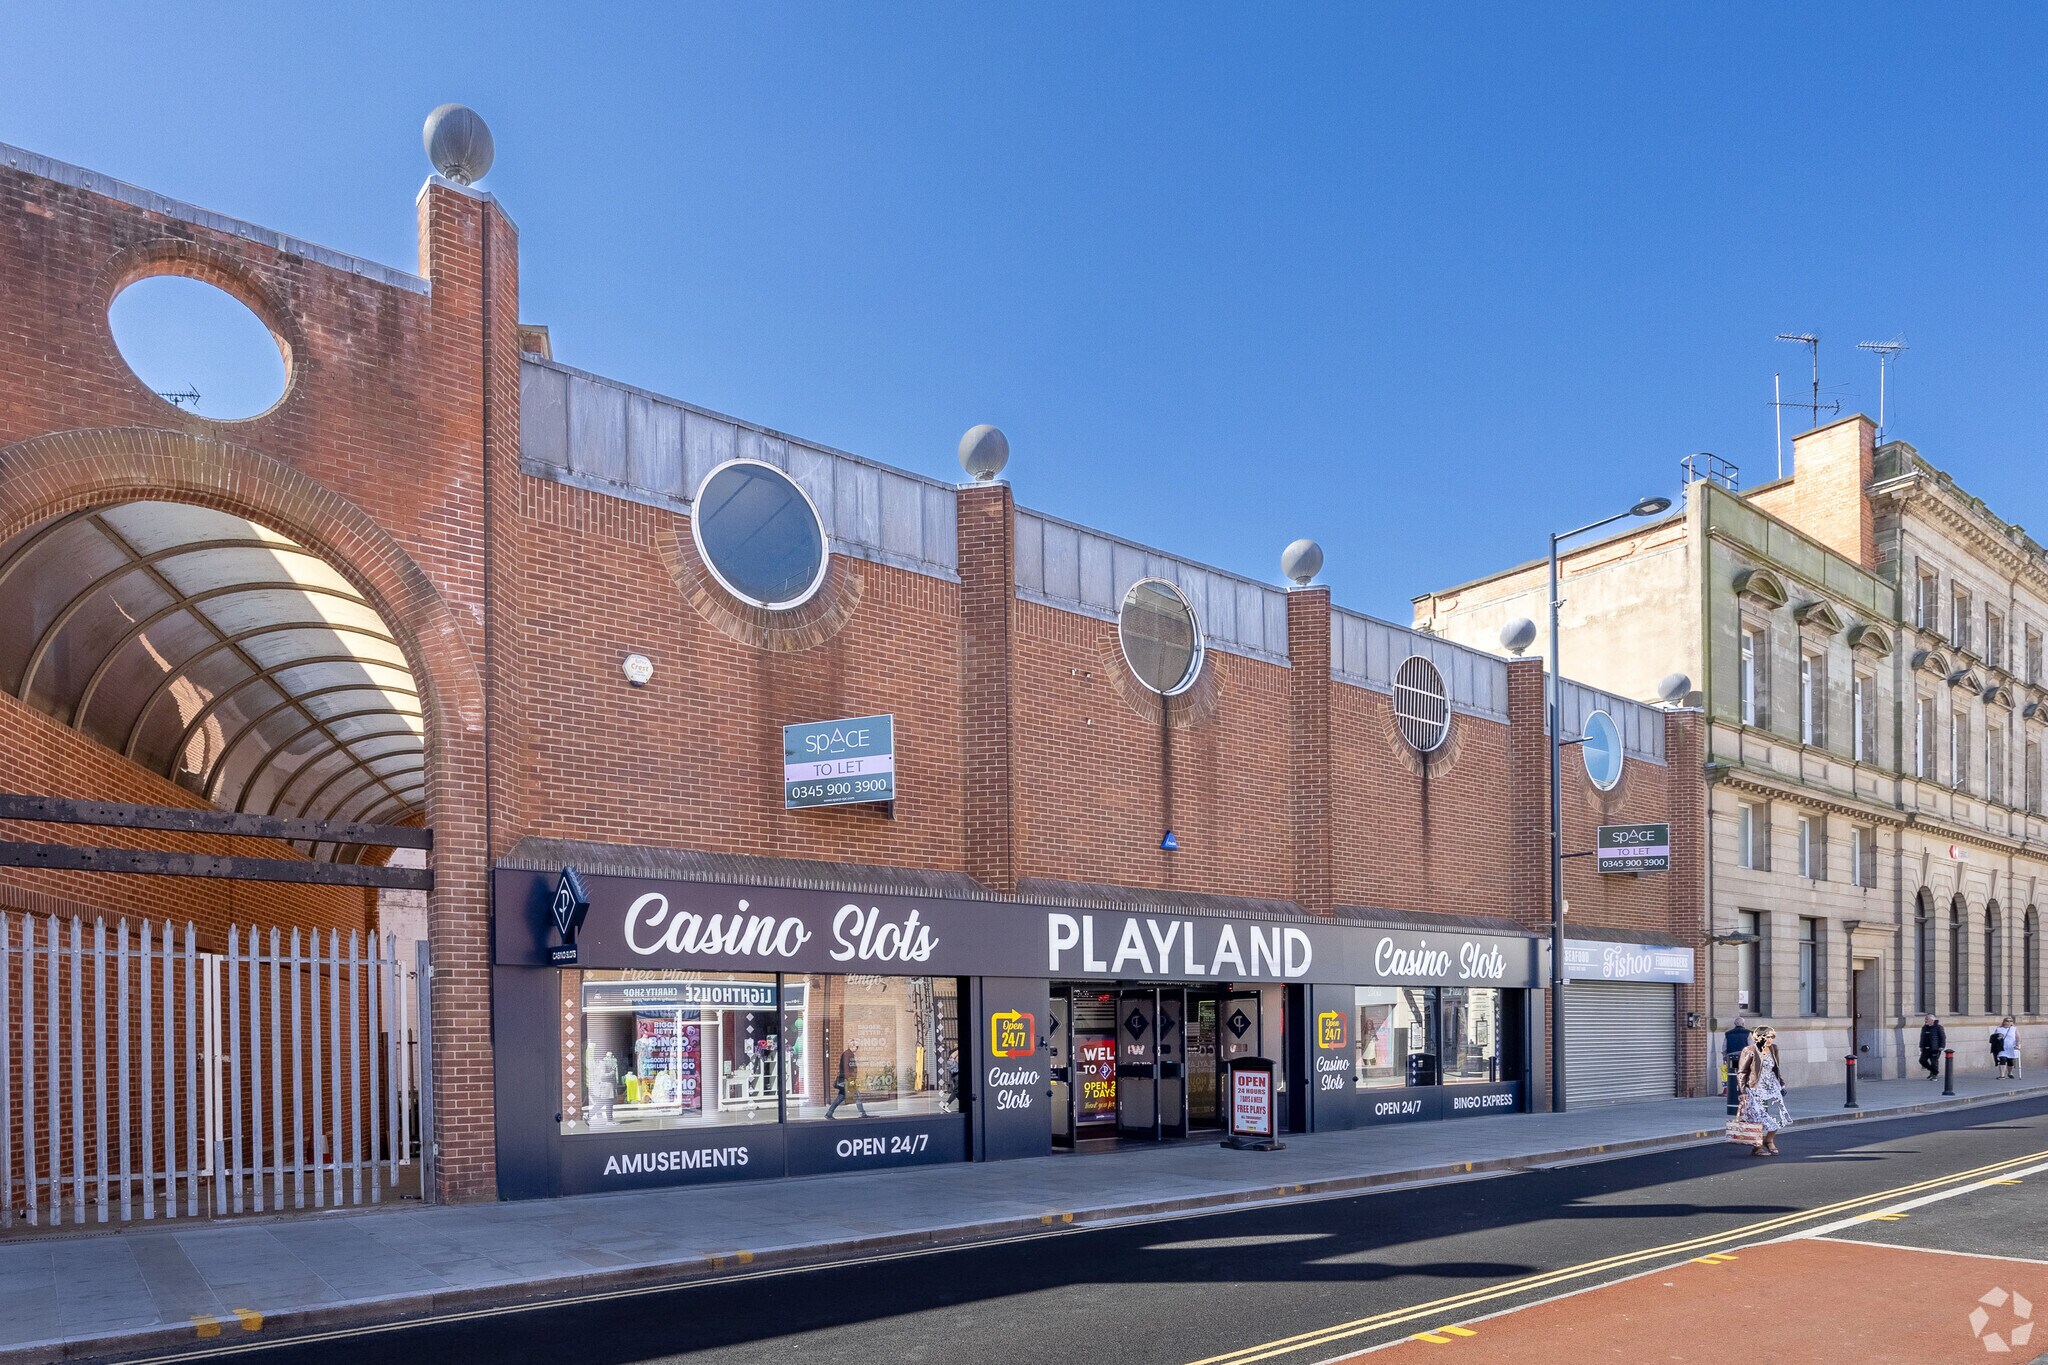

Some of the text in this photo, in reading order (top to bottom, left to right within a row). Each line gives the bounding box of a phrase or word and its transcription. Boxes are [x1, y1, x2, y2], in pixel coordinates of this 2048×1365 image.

[813, 760, 864, 777] TO LET
[792, 779, 887, 799] 0345 900 3900
[1643, 858, 1665, 866] 3900
[624, 892, 939, 961] Casino Slots
[1048, 913, 1312, 977] PLAYLAND
[1375, 937, 1506, 979] Casino Slots
[1564, 950, 1590, 963] SEAFOOD
[1602, 946, 1652, 977] Fishoo
[1002, 1020, 1024, 1033] Open
[1325, 1019, 1340, 1030] Open
[1001, 1032, 1026, 1047] 24/7
[1325, 1028, 1341, 1041] 24/7
[1084, 1048, 1115, 1061] WEL
[1083, 1065, 1097, 1075] TO
[1316, 1056, 1350, 1072] Casino
[988, 1066, 1040, 1087] Casino
[1238, 1076, 1266, 1087] OPEN
[1321, 1074, 1345, 1091] Slots
[1084, 1082, 1108, 1090] OPEN
[996, 1089, 1033, 1110] Slots
[1085, 1089, 1115, 1099] 7 DAYS
[1454, 1094, 1512, 1109] BINGO EXPRESS
[1237, 1104, 1266, 1115] FREE PLAYS
[1375, 1100, 1421, 1115] OPEN 24/7
[837, 1134, 929, 1157] OPEN 24/7
[604, 1146, 749, 1175] AMUSEMENTS
